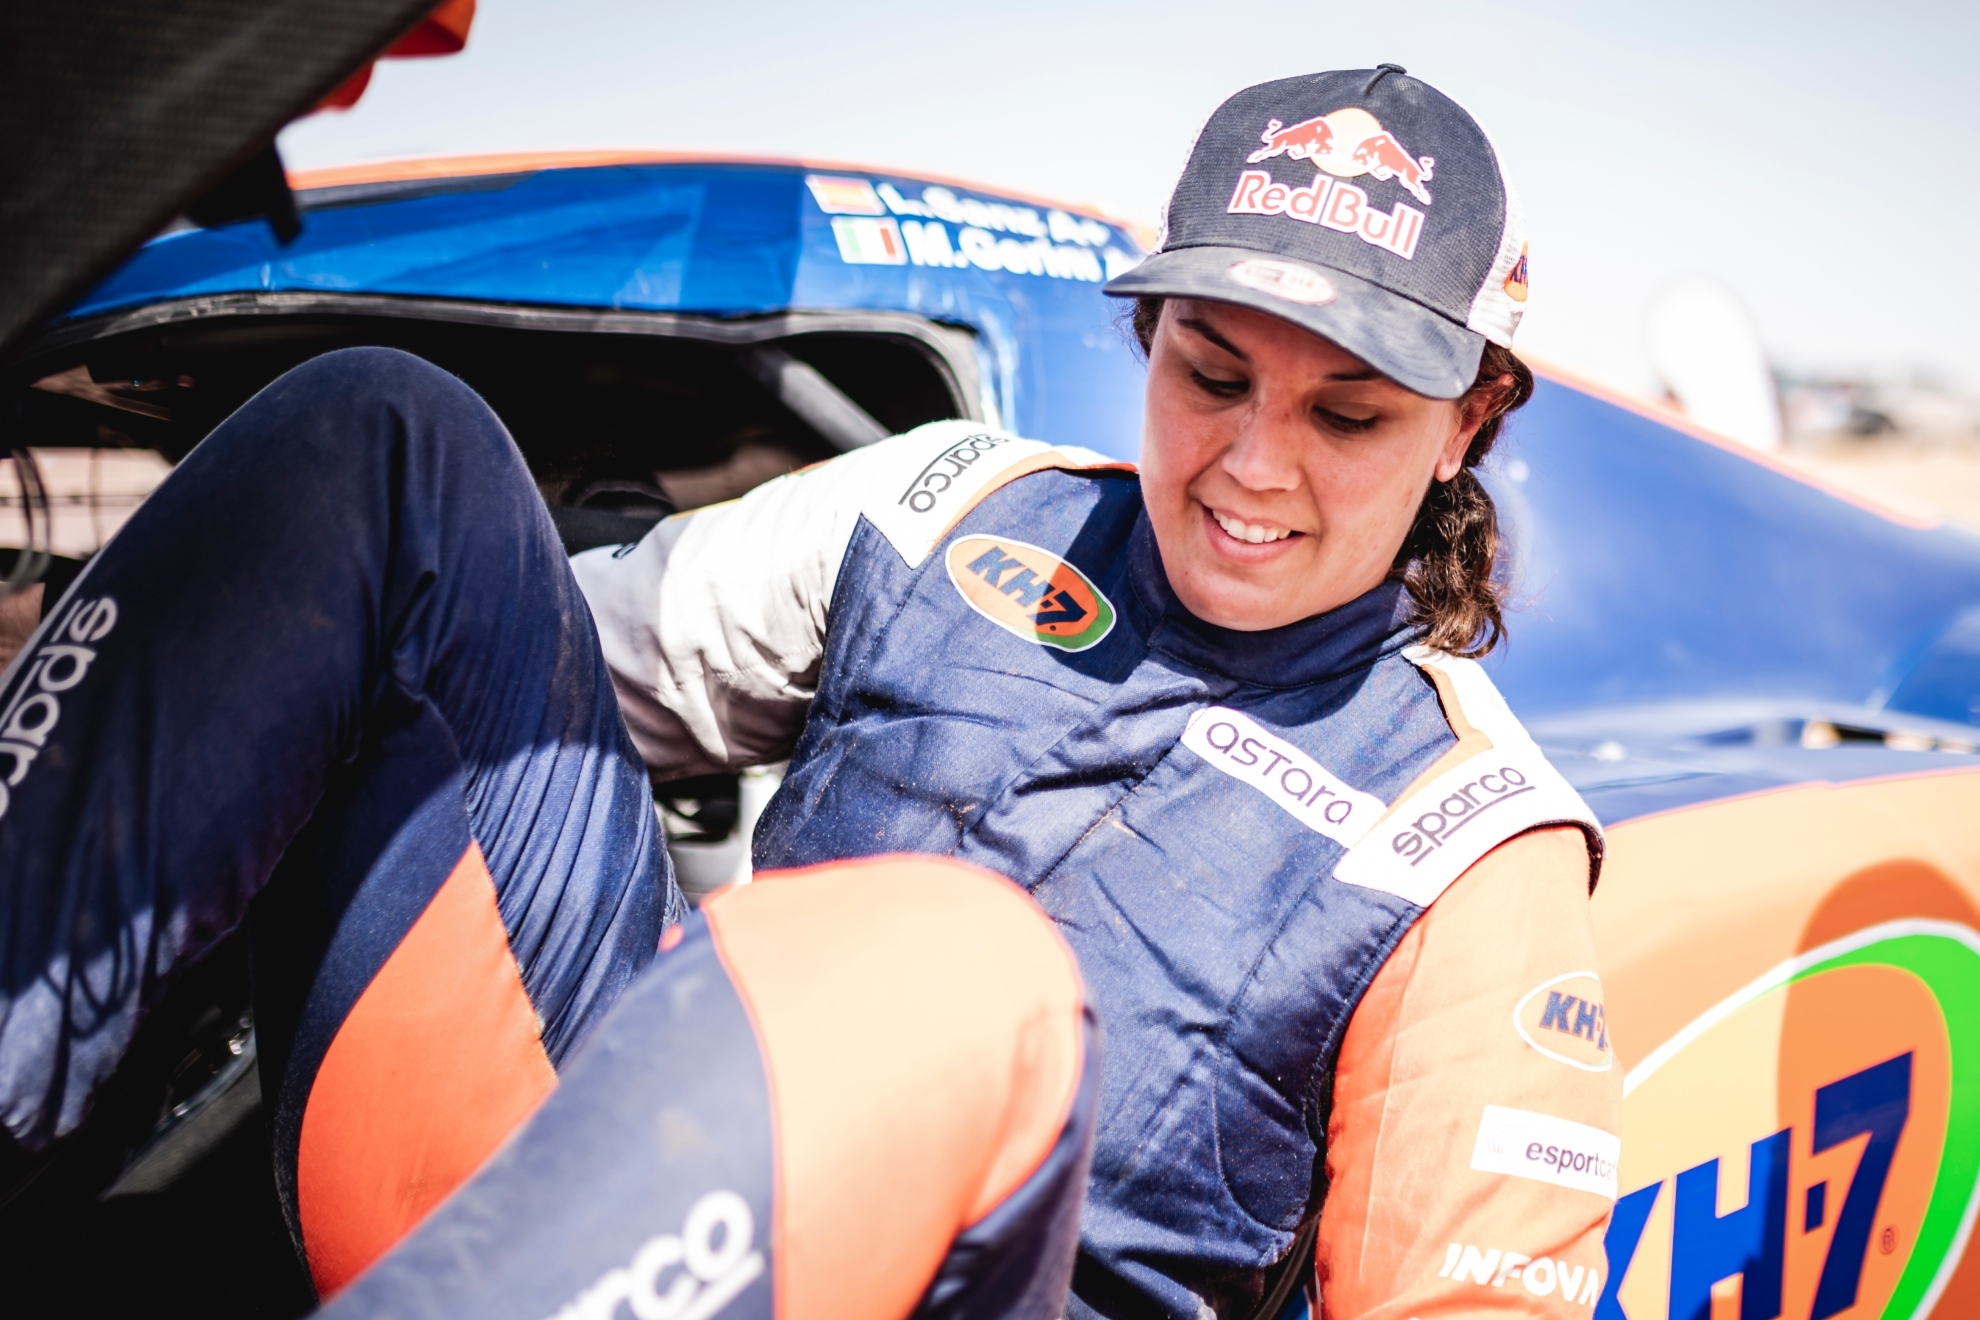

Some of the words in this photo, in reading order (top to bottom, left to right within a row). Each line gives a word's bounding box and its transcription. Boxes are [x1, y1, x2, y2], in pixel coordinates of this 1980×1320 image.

[1230, 172, 1330, 221] Red
[1324, 180, 1423, 256] Bull
[904, 433, 1010, 513] sparco
[0, 596, 118, 818] spar
[1205, 720, 1354, 827] astara
[1391, 766, 1530, 866] sparco
